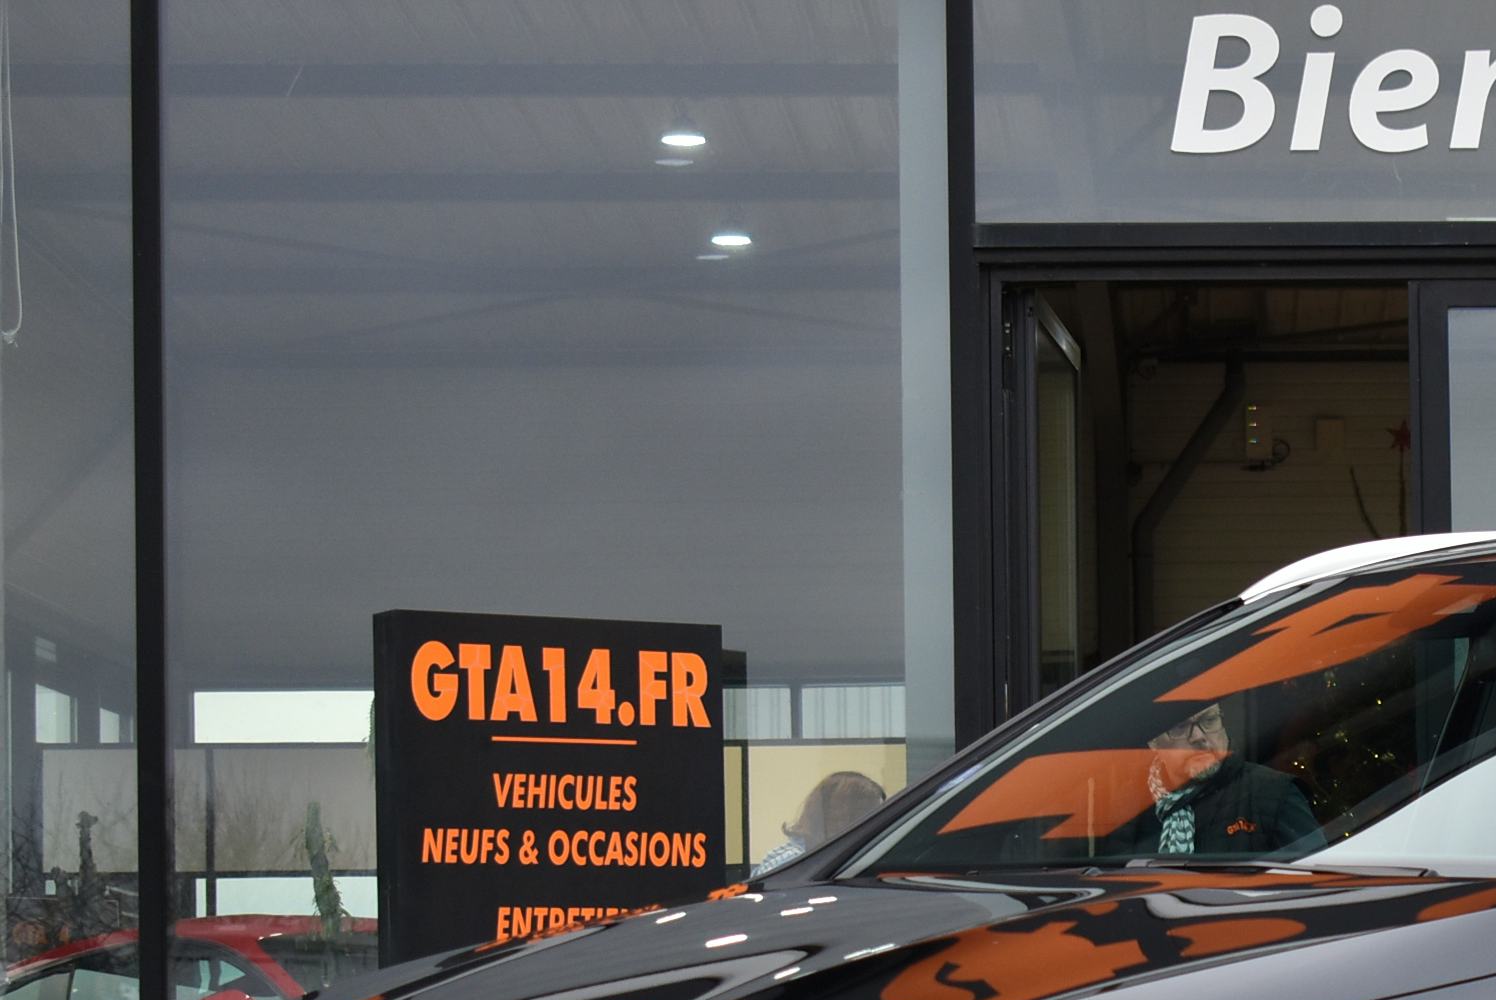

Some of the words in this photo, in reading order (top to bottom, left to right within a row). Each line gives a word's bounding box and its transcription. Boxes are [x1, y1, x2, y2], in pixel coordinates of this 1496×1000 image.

[411, 640, 711, 728] GTA14.FR
[492, 773, 637, 811] VEHICULES
[421, 828, 510, 864] NEUFS
[518, 830, 540, 865] &
[547, 829, 708, 868] OCCASIONS
[496, 906, 629, 940] ENTRE
